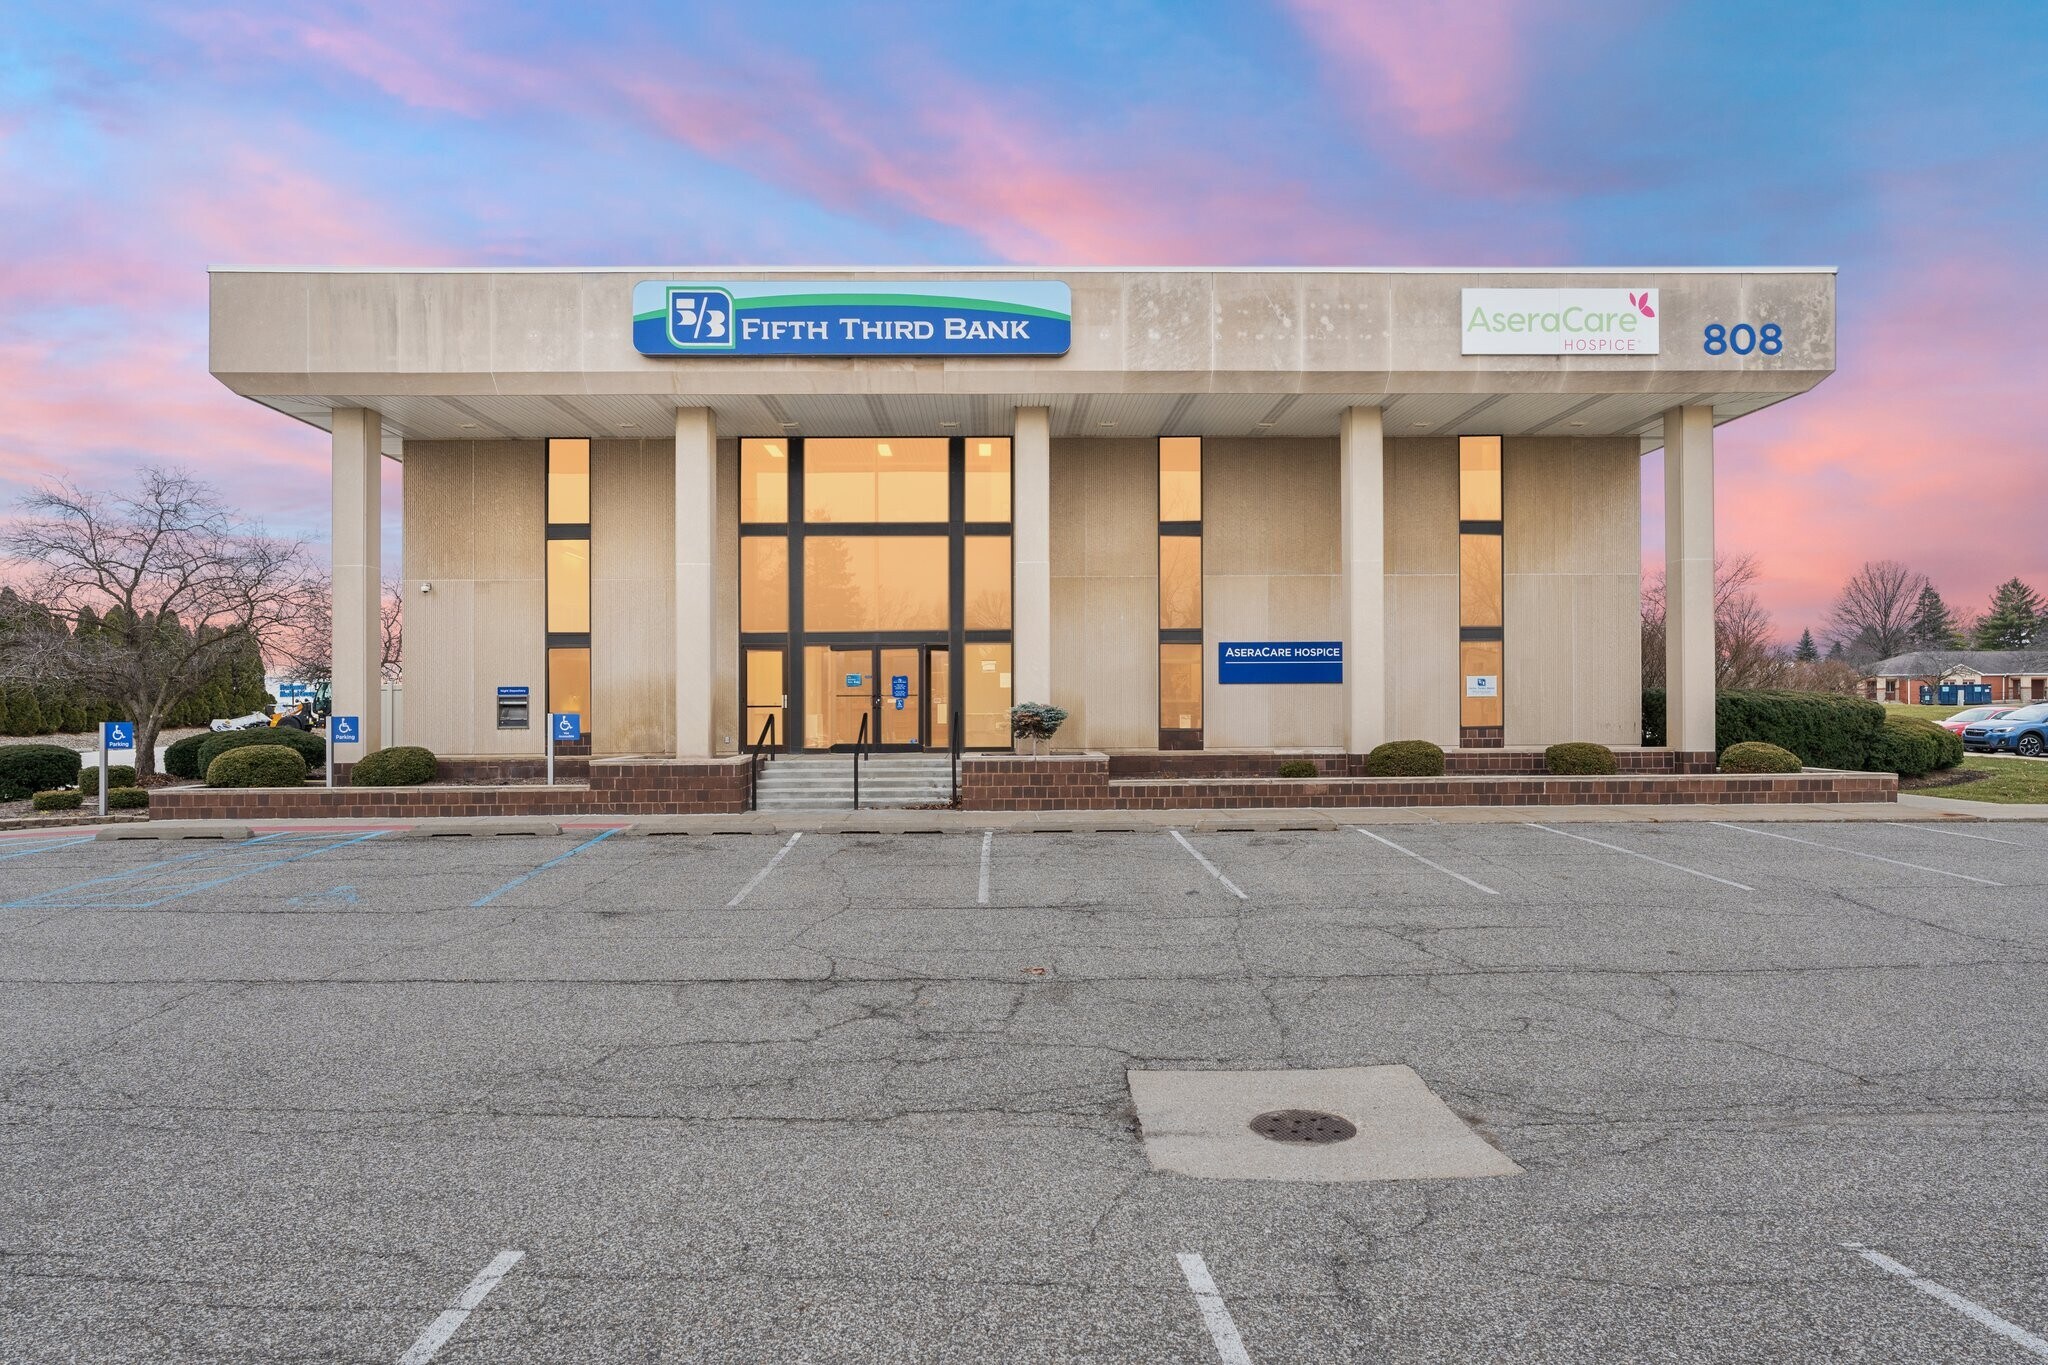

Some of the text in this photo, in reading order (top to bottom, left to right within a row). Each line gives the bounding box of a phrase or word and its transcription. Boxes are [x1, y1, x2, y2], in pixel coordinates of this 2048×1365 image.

[741, 317, 1030, 340] FIFTH THIRD BANK
[1467, 306, 1638, 333] AseraCare
[1564, 339, 1635, 351] HOSPICE
[1703, 323, 1783, 356] 808
[1294, 647, 1340, 657] HOSPICE
